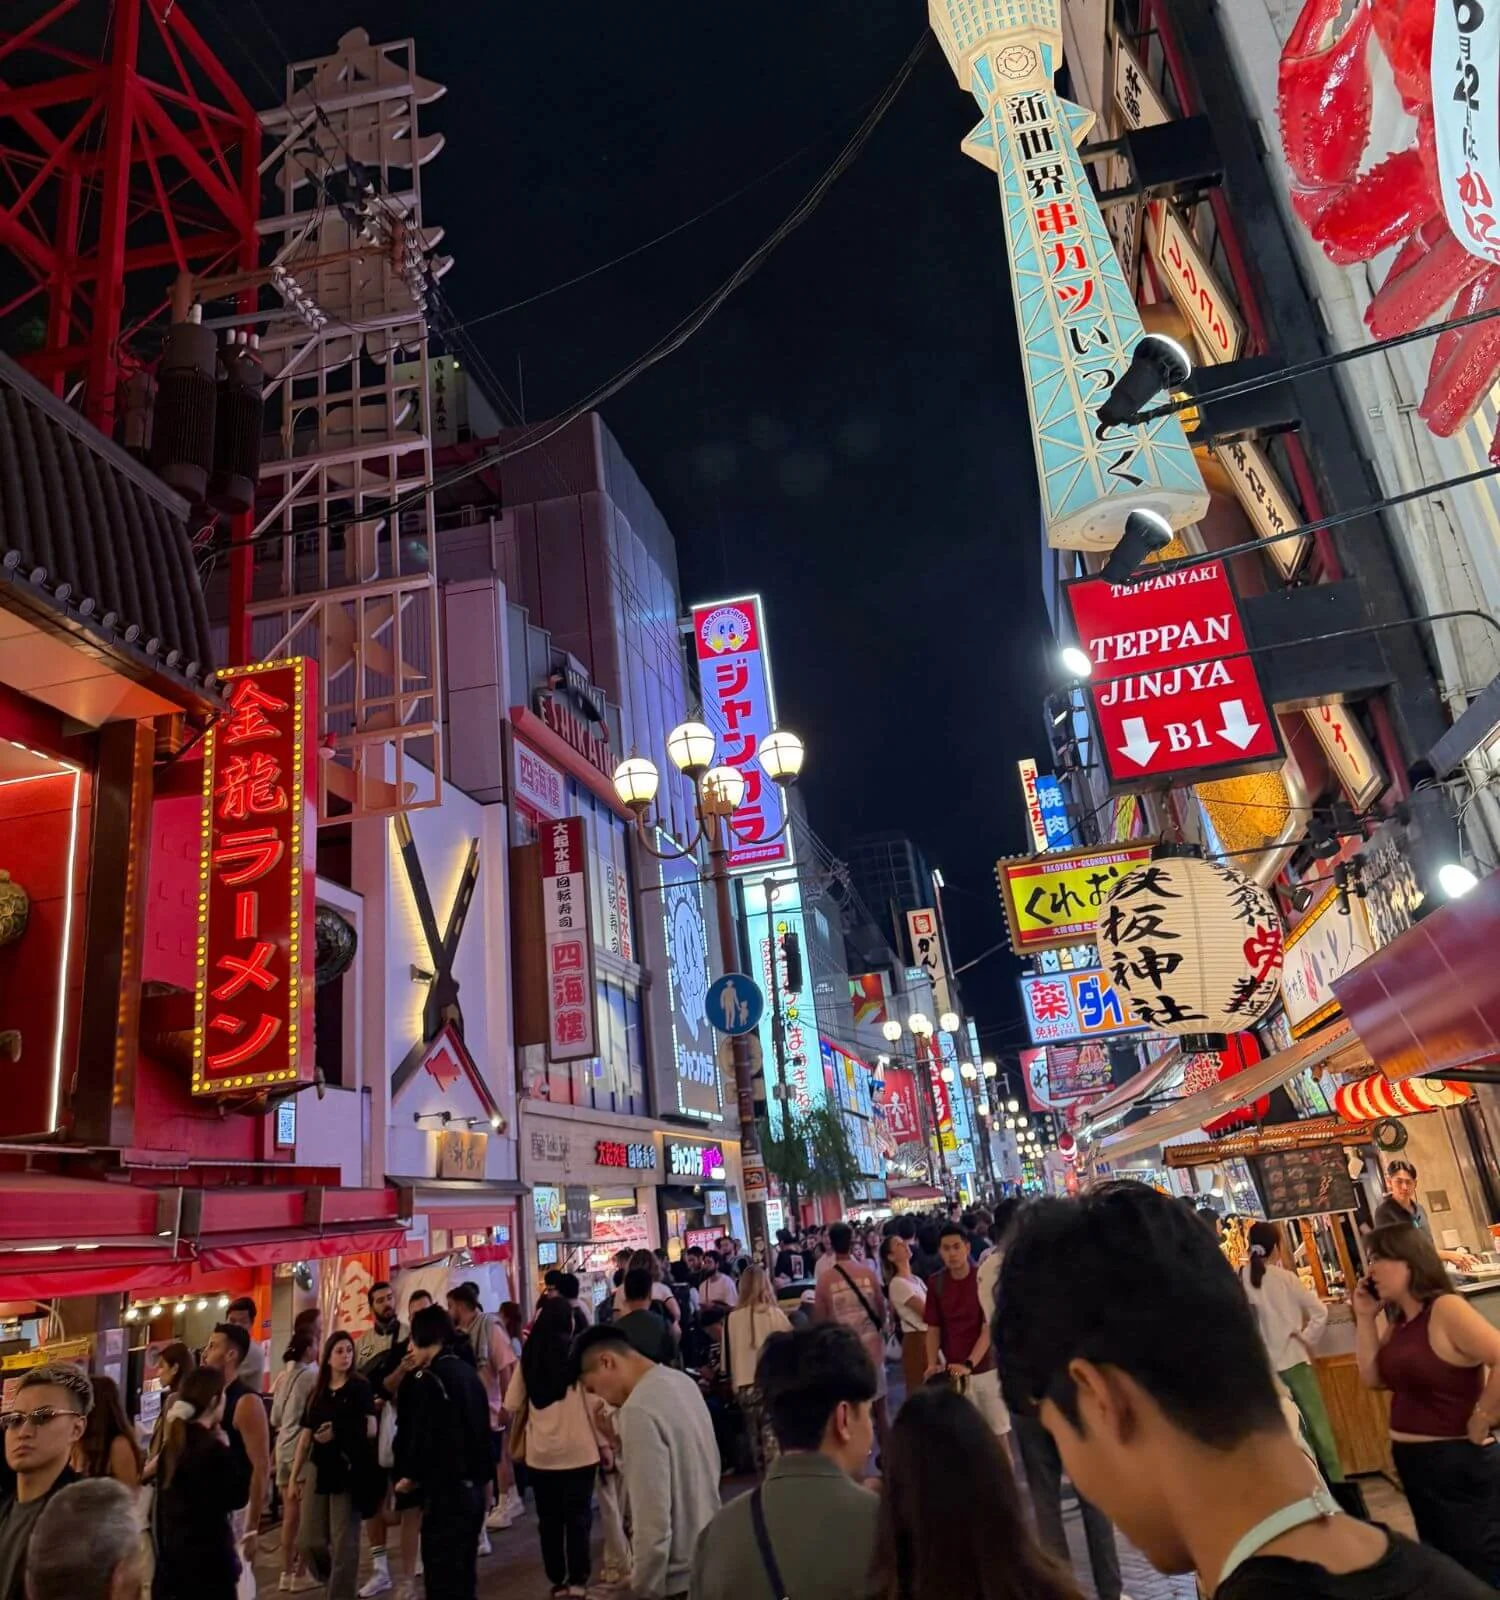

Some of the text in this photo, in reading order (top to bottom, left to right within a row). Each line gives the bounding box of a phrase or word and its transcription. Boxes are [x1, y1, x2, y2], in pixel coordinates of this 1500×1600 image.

[1111, 566, 1218, 598] TEPPANYAKI
[1090, 614, 1232, 664] TEPPAN
[1101, 660, 1234, 706] JINJYA
[1165, 719, 1211, 753] B1
[1038, 786, 1069, 838] 焼肉
[552, 823, 571, 874] 大起水産
[207, 679, 291, 1070] 金龍ラーメン
[555, 876, 573, 929] 回転寿司
[1101, 867, 1209, 1028] 鉄板神社
[1029, 980, 1071, 1021] 薬
